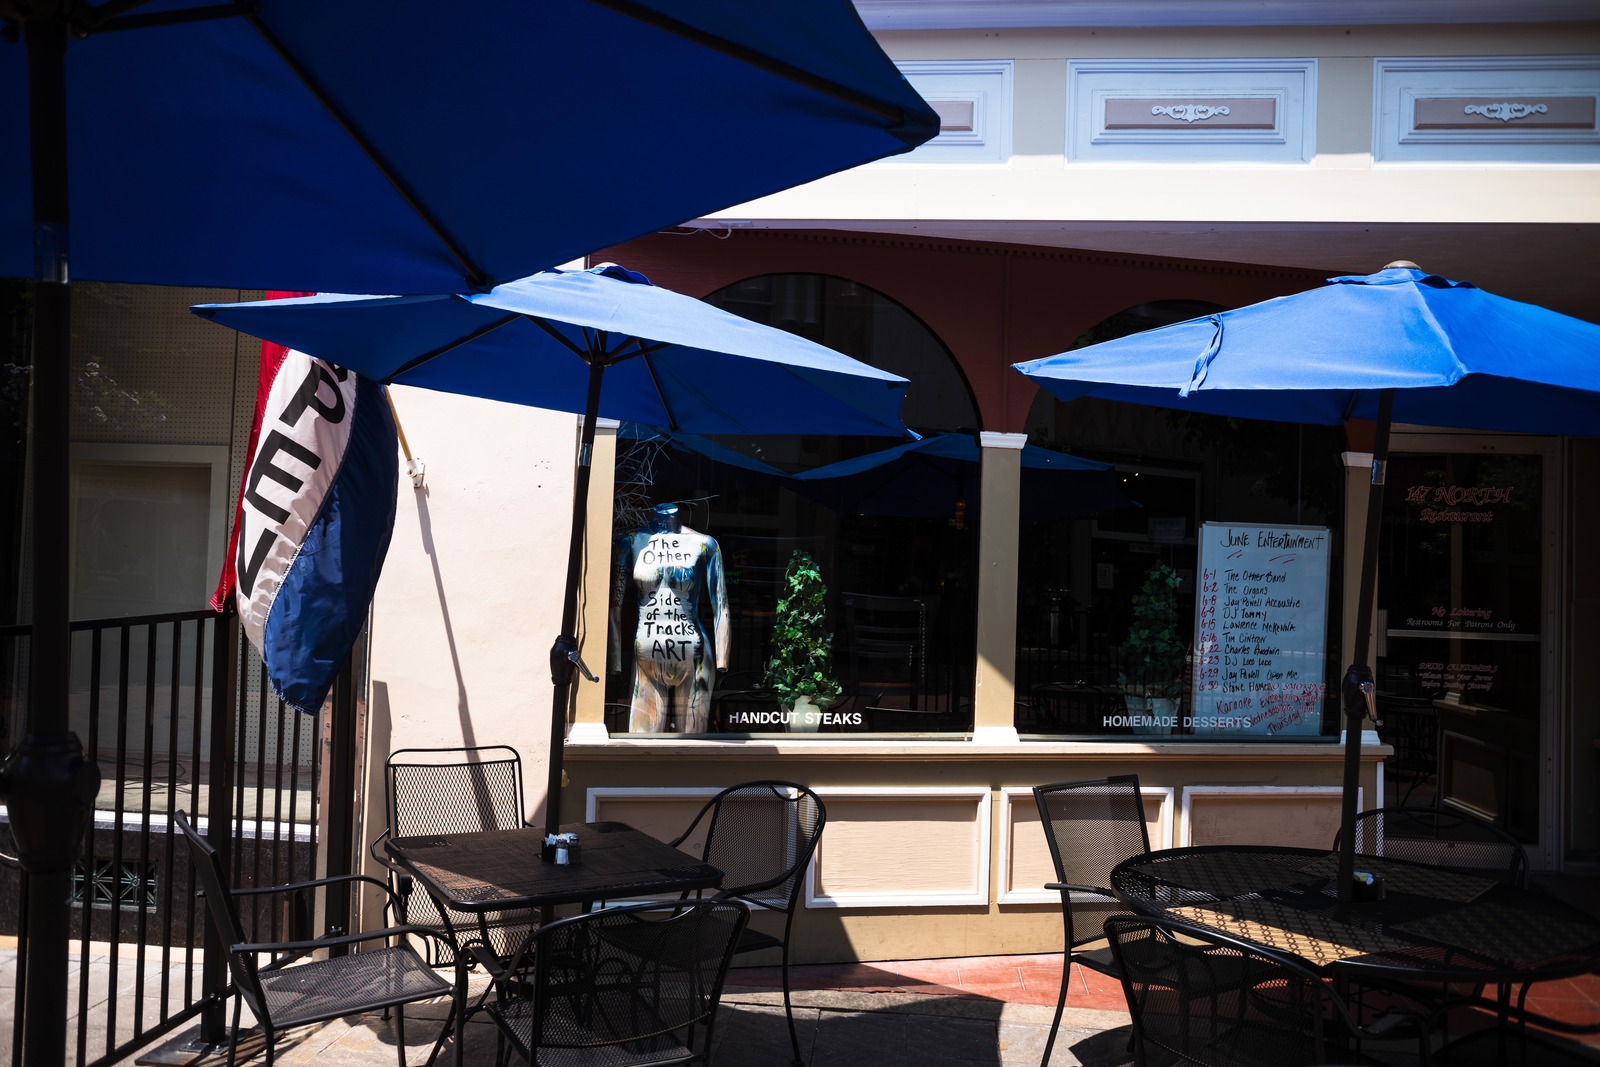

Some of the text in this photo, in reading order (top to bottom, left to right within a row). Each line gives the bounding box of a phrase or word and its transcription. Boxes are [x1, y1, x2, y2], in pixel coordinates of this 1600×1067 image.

[1404, 485, 1514, 507] 147 NORTH
[1419, 508, 1494, 524] Restaurant
[649, 538, 680, 550] The
[1220, 529, 1324, 550] JUNE ENTERTAINMENT
[643, 550, 691, 564] Other
[1203, 568, 1216, 580] 6-1
[1225, 569, 1239, 581] The
[1243, 570, 1265, 582] Other
[1203, 582, 1268, 599] 6-2 The Organs
[647, 591, 681, 607] Side
[1202, 595, 1216, 606] 6-8
[1224, 596, 1239, 611] Jay
[1241, 597, 1261, 607] Powell
[646, 608, 687, 621] of the
[1201, 606, 1267, 621] 6-9 DJ Tommy
[1449, 607, 1493, 620] Loitering
[644, 622, 695, 638] Tracks
[1201, 619, 1216, 630] 6-15
[1223, 619, 1257, 630] Lawrence
[1406, 617, 1516, 630] Restrooms For Patrons Only
[651, 638, 692, 662] ART
[1224, 644, 1250, 655] Charles
[1225, 655, 1237, 666] DJ
[1222, 667, 1237, 683] Jay
[1240, 668, 1260, 679] Powell
[1215, 697, 1253, 715] Karaoke
[729, 711, 862, 725] HANDCUT STEAKS
[1103, 715, 1178, 727] HOMEMADE
[1183, 716, 1251, 728] DESSERTS
[1267, 709, 1303, 734] Thursday
